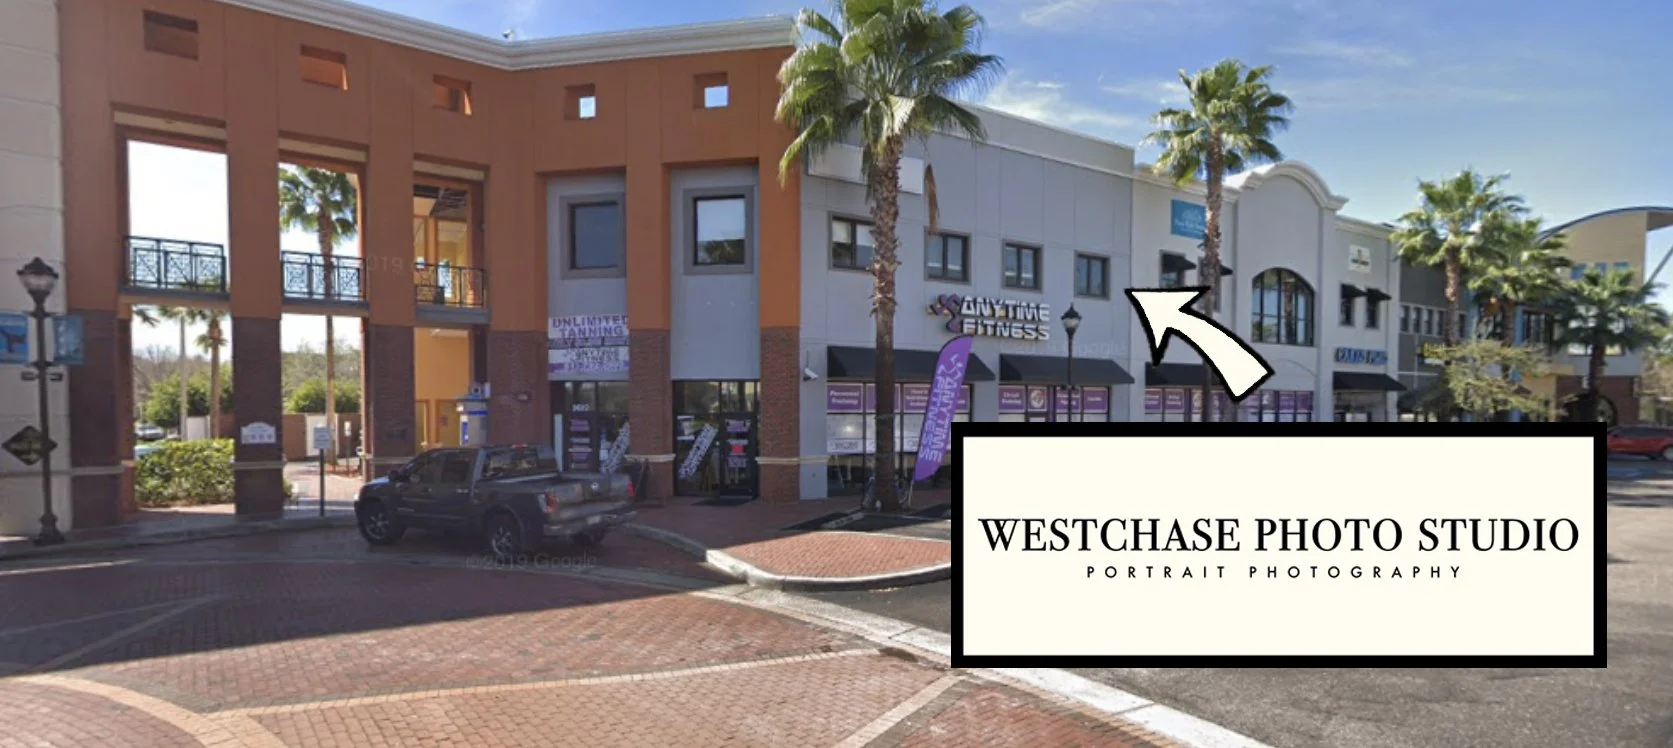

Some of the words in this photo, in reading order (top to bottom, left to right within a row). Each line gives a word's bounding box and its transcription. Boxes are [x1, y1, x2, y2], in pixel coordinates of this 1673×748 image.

[961, 295, 1050, 321] ANYTIME
[560, 326, 624, 338] TANNING
[962, 318, 1050, 341] FITNESS
[919, 376, 946, 461] FITNESS
[930, 377, 957, 463] ANYTIME
